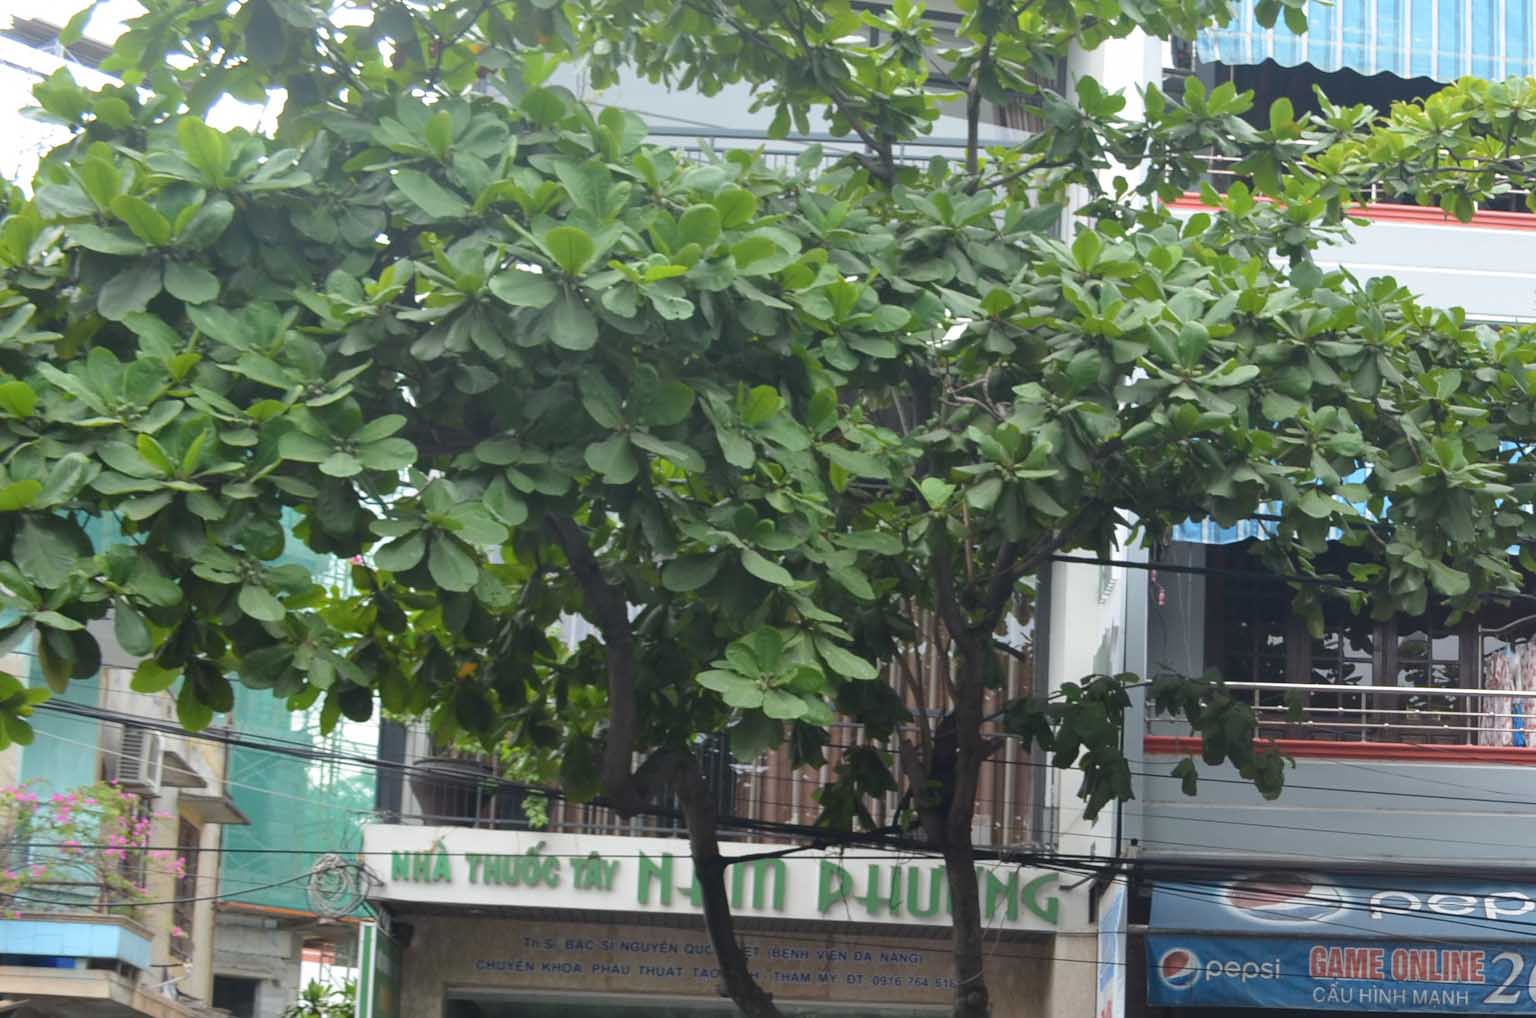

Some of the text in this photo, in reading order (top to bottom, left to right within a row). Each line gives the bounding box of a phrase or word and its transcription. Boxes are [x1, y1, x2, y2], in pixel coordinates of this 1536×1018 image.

[638, 850, 786, 912] NM
[1205, 958, 1281, 983] pepsi
[1308, 945, 1385, 981] GAME
[1391, 948, 1486, 984] ONLINE
